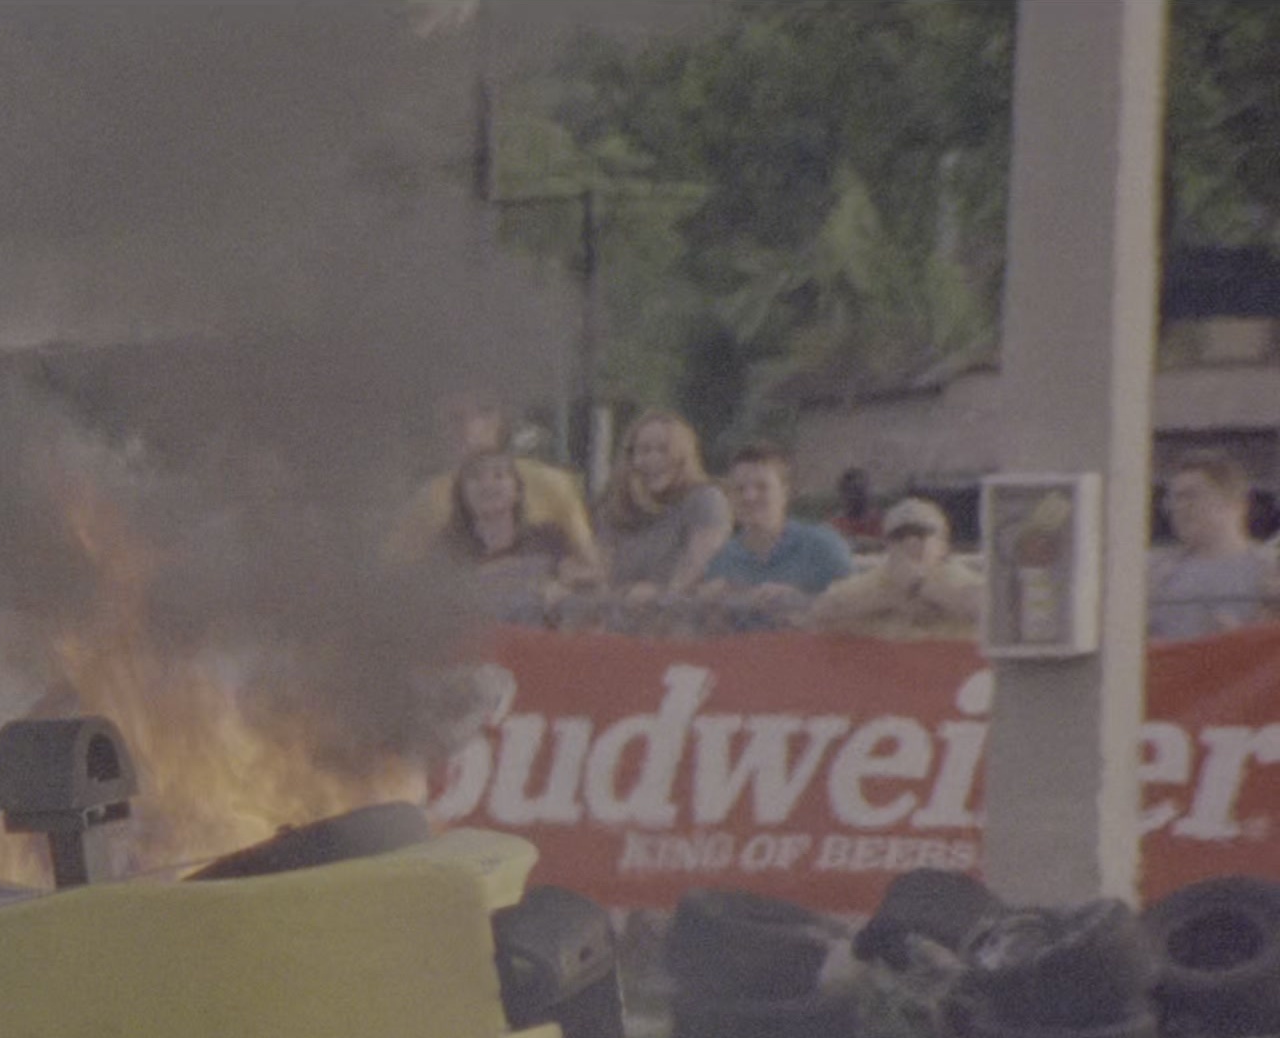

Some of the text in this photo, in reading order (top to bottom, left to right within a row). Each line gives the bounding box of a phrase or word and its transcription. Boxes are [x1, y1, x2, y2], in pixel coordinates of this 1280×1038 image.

[428, 662, 1280, 842] udweier
[617, 831, 737, 873] KING
[739, 833, 813, 872] OF
